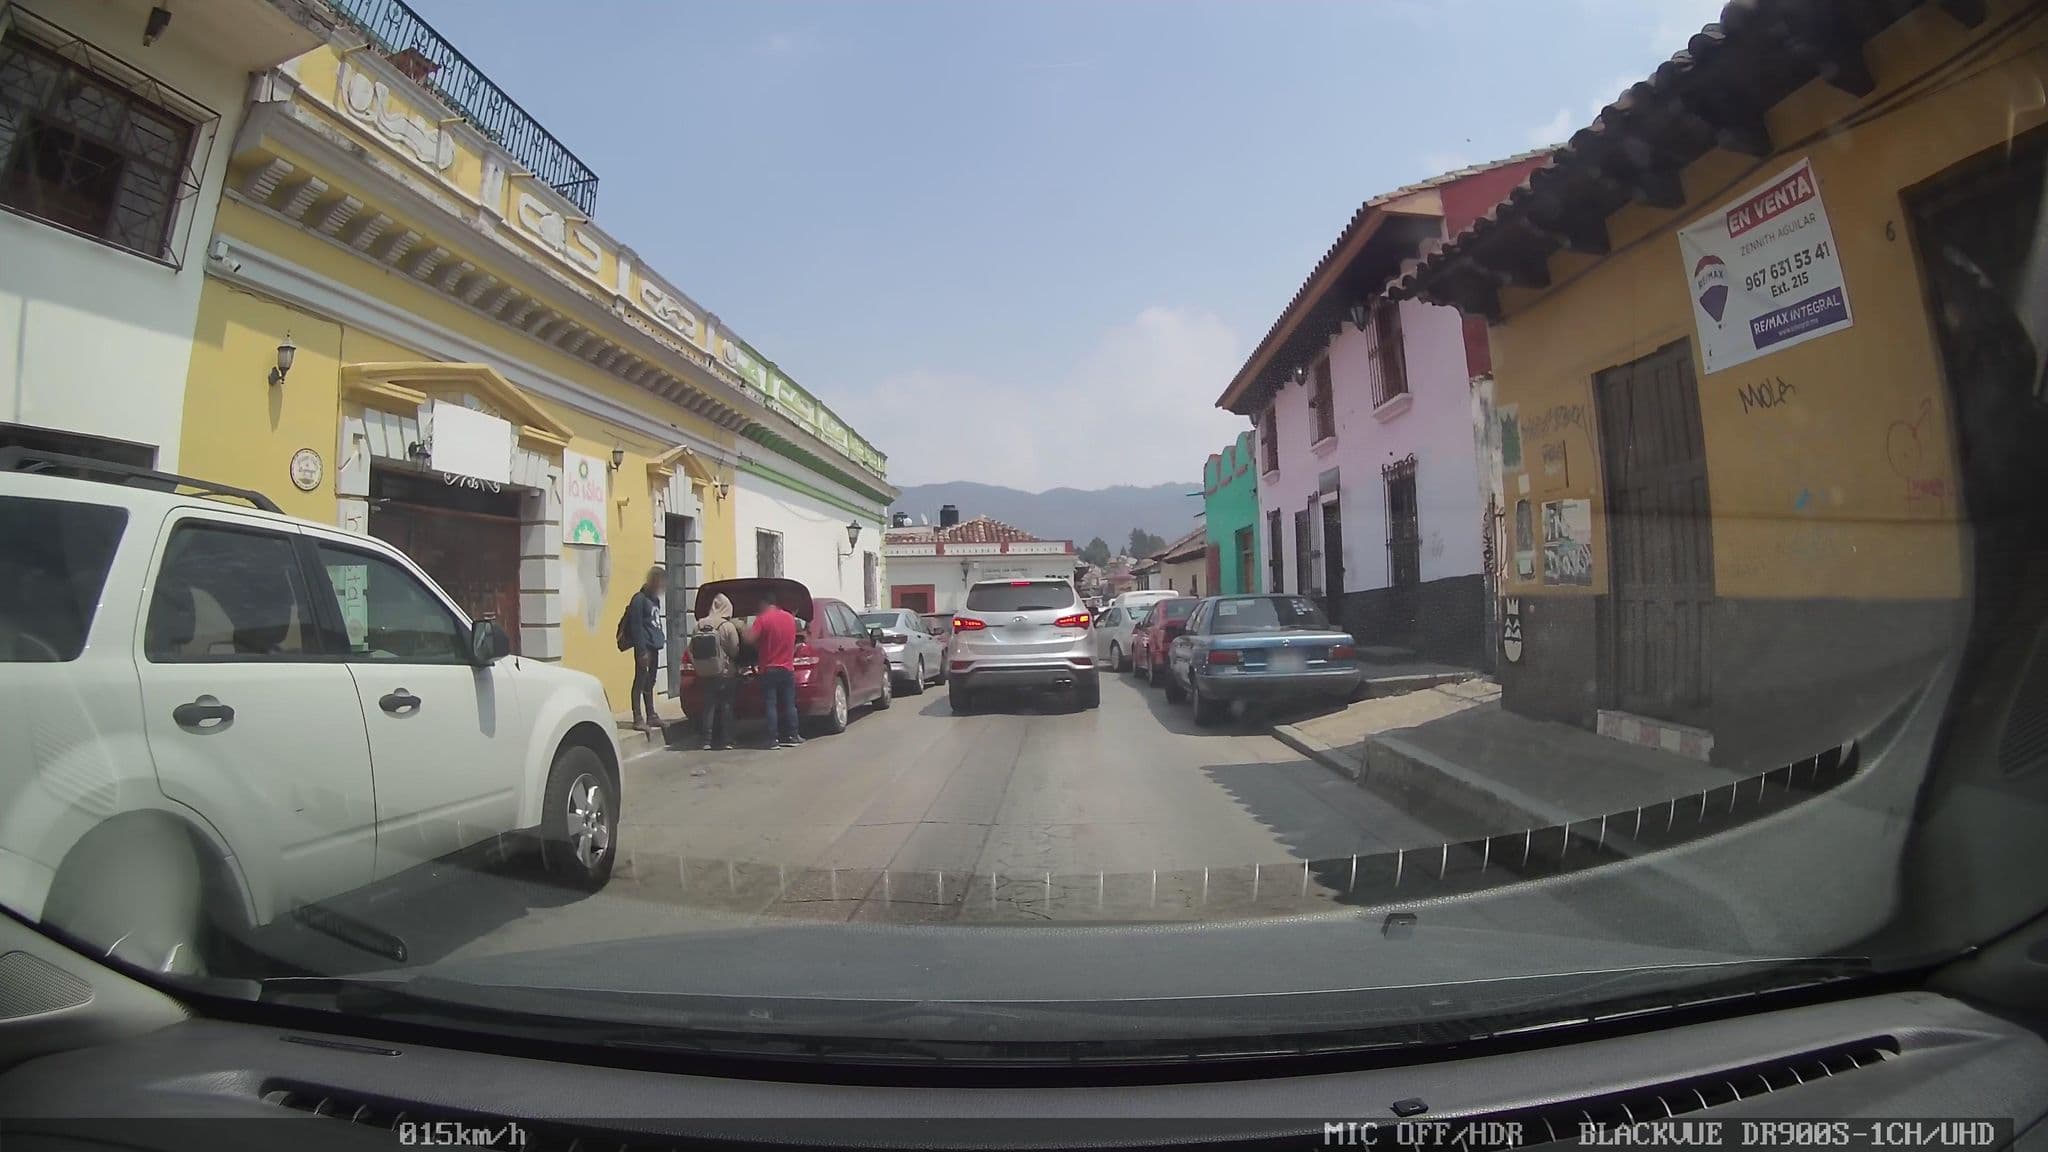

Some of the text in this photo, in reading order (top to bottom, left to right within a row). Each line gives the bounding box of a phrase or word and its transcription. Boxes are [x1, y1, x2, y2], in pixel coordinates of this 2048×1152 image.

[1729, 176, 1812, 234] EN VENTA
[1740, 213, 1817, 257] ZENNITH AGUILAR
[1697, 269, 1724, 290] RE/MAX
[1745, 240, 1831, 292] 967 631 53 41
[1770, 271, 1809, 299] Ext. 215
[1753, 313, 1789, 335] RE/MAX
[1790, 294, 1841, 322] INTEGRAL
